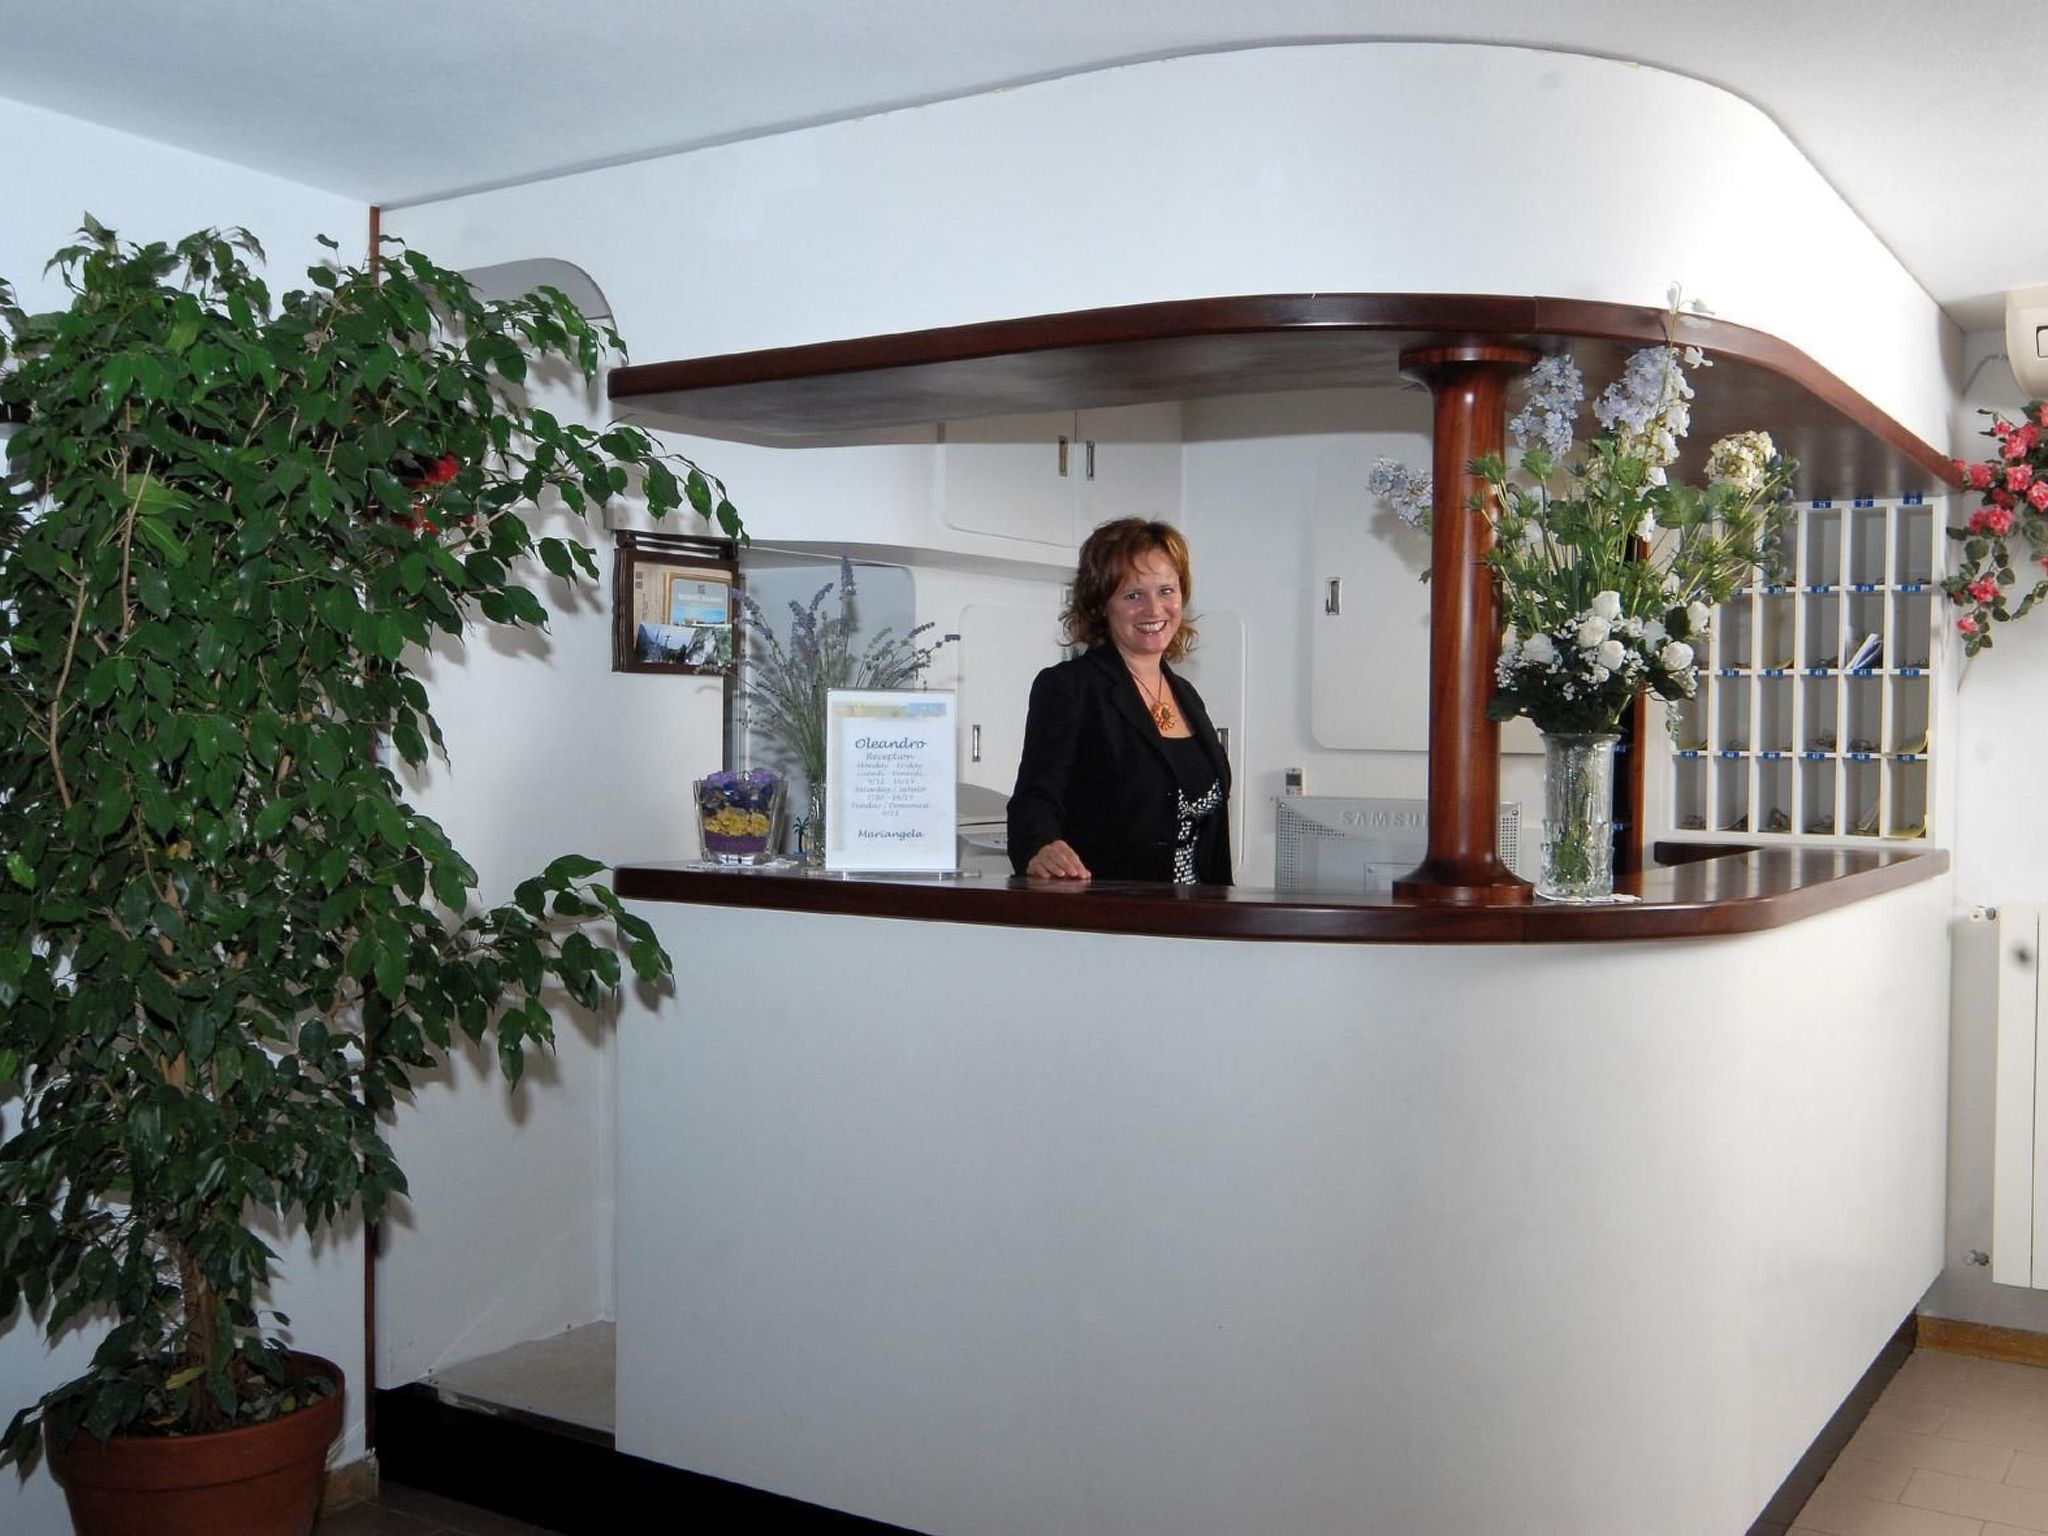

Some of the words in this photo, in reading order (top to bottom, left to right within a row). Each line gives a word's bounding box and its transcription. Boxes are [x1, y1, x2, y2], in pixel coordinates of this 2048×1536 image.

[855, 737, 927, 749] Oleandro
[866, 752, 914, 762] Reception
[1341, 812, 1428, 826] SAMSU
[857, 828, 924, 842] Mariangela
